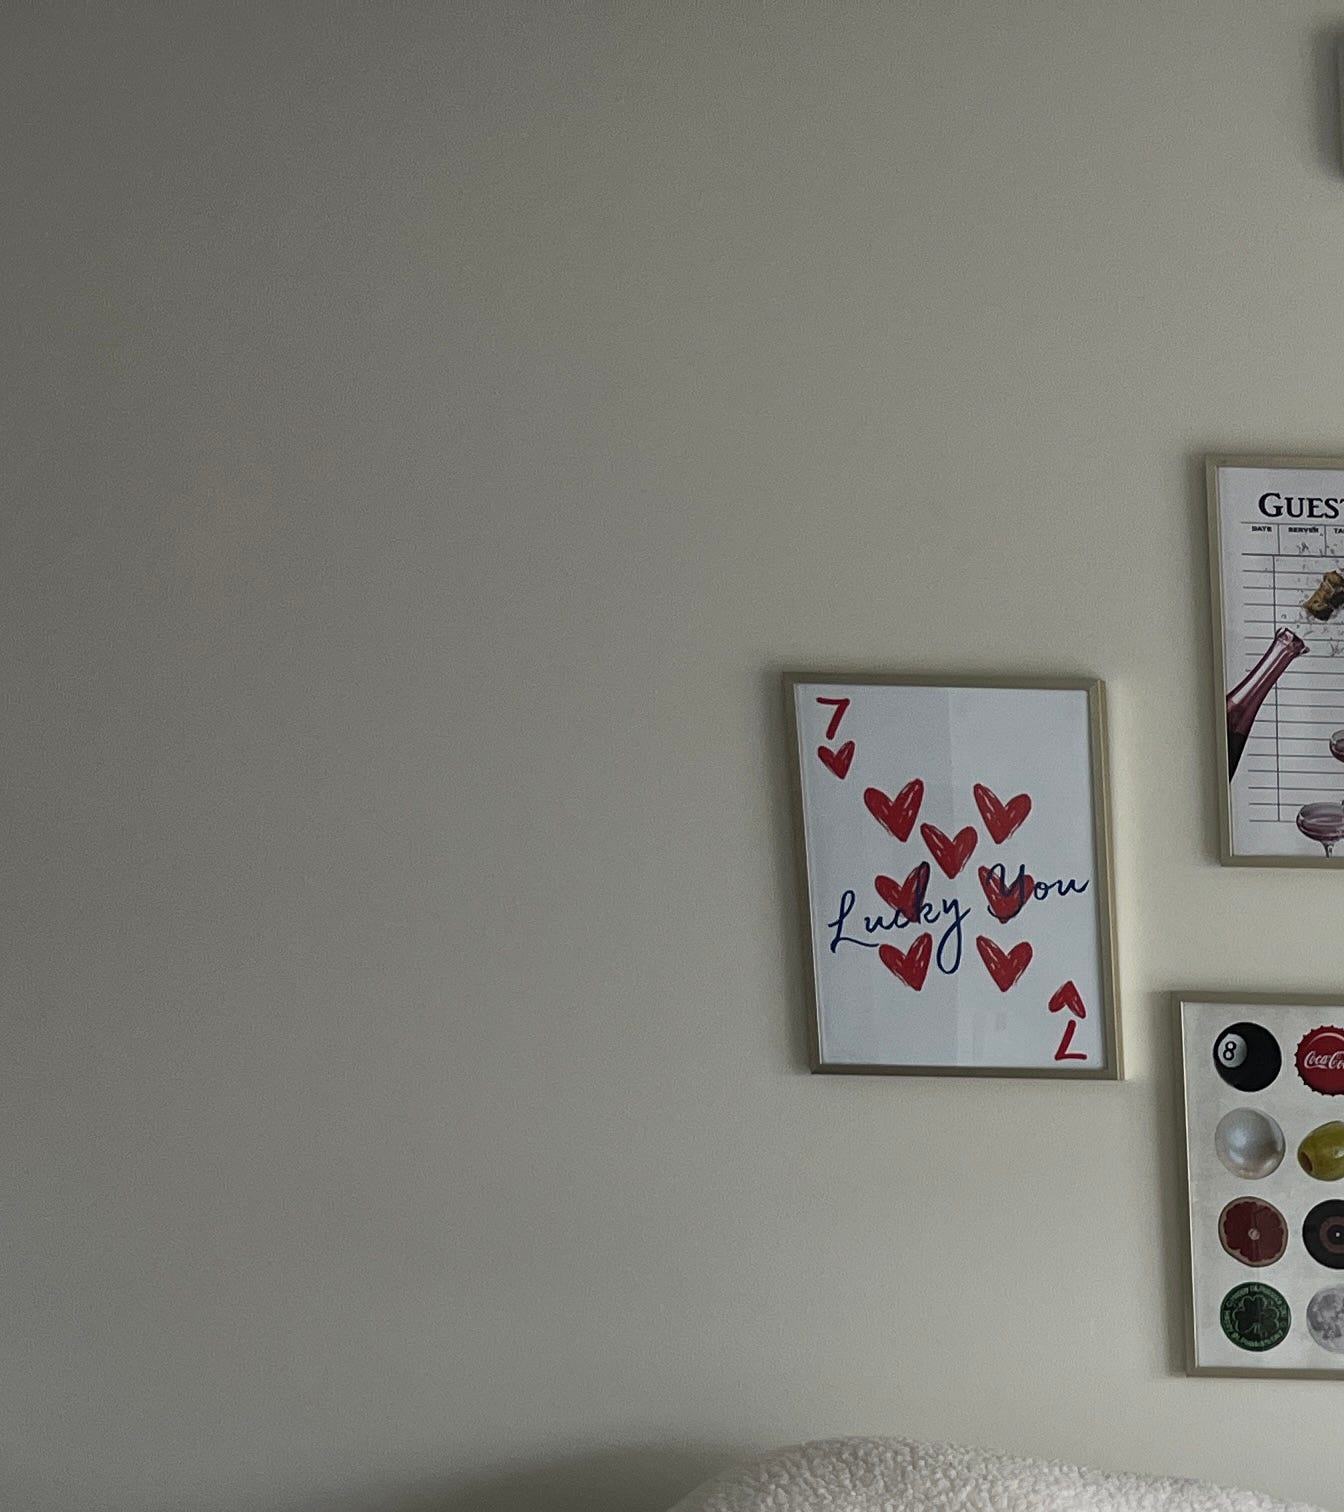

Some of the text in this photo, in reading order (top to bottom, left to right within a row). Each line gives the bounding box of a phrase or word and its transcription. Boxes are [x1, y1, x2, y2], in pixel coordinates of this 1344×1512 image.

[816, 696, 851, 741] 7
[828, 860, 1090, 975] Lucky You
[1054, 1019, 1088, 1062] 7
[1222, 1040, 1237, 1061] 8
